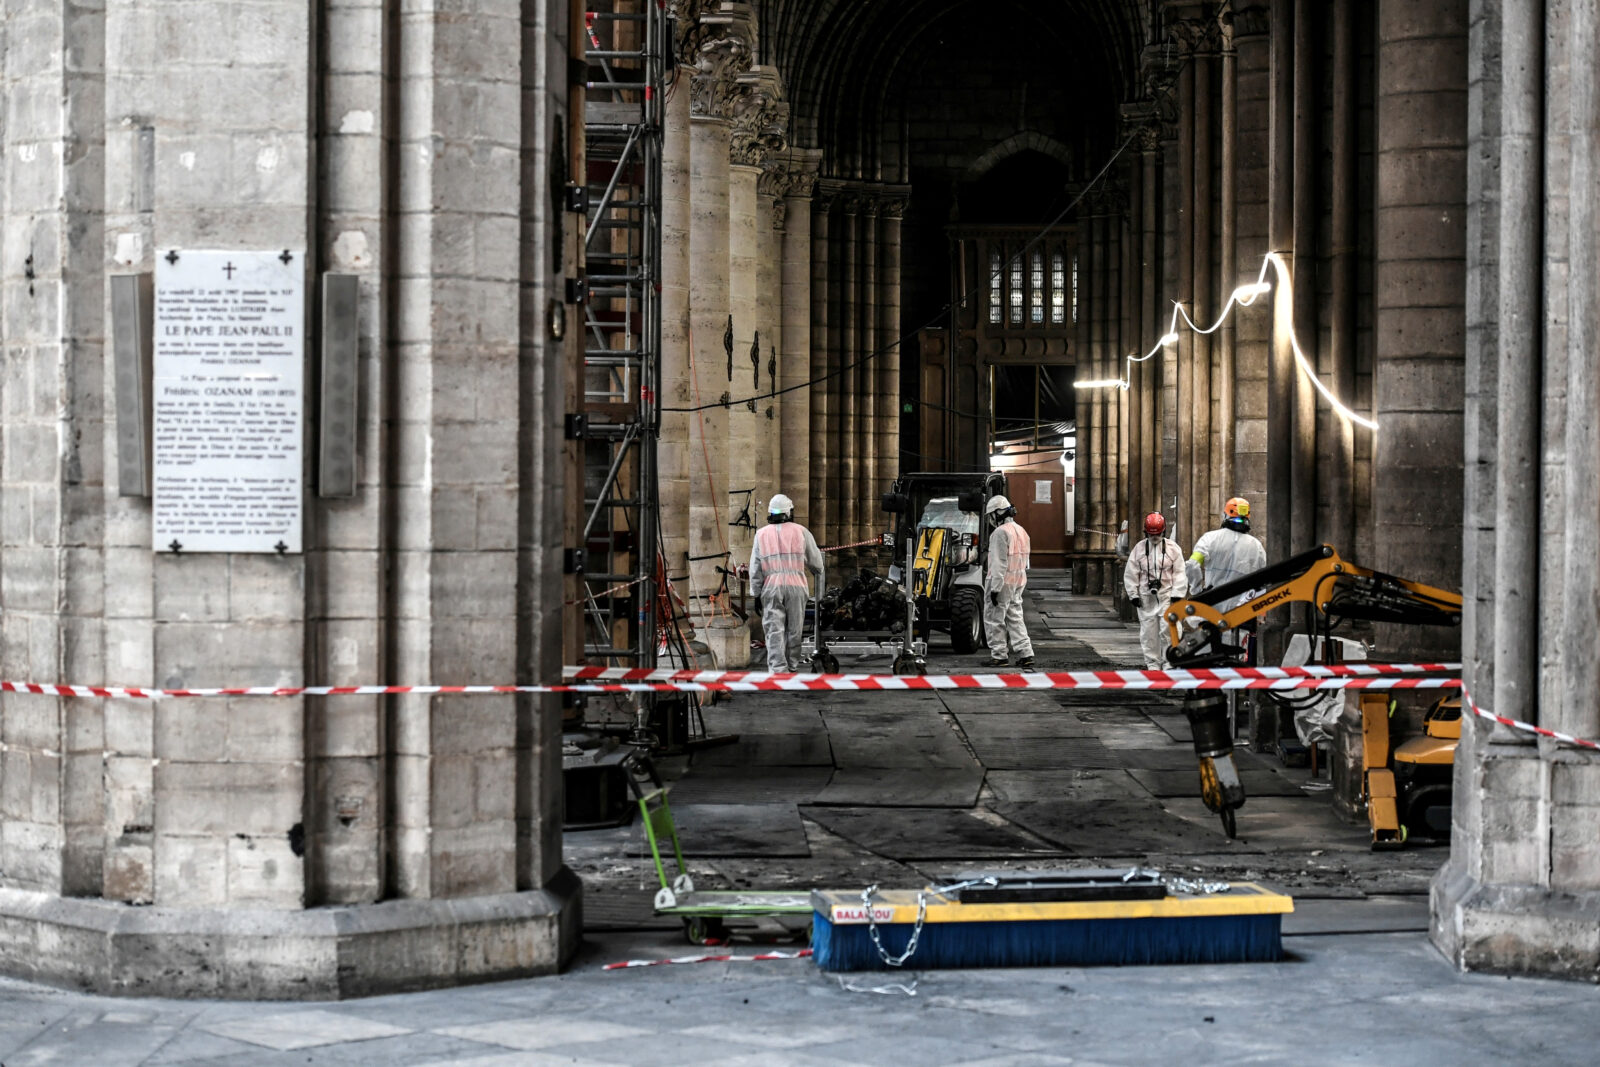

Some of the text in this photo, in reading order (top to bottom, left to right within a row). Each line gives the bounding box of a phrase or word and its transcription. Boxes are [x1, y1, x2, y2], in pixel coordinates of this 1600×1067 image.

[165, 325, 180, 336] LE
[184, 325, 214, 336] PAPE
[284, 326, 293, 337] II
[204, 387, 253, 397] OZANAM
[1251, 587, 1292, 612] BROKK
